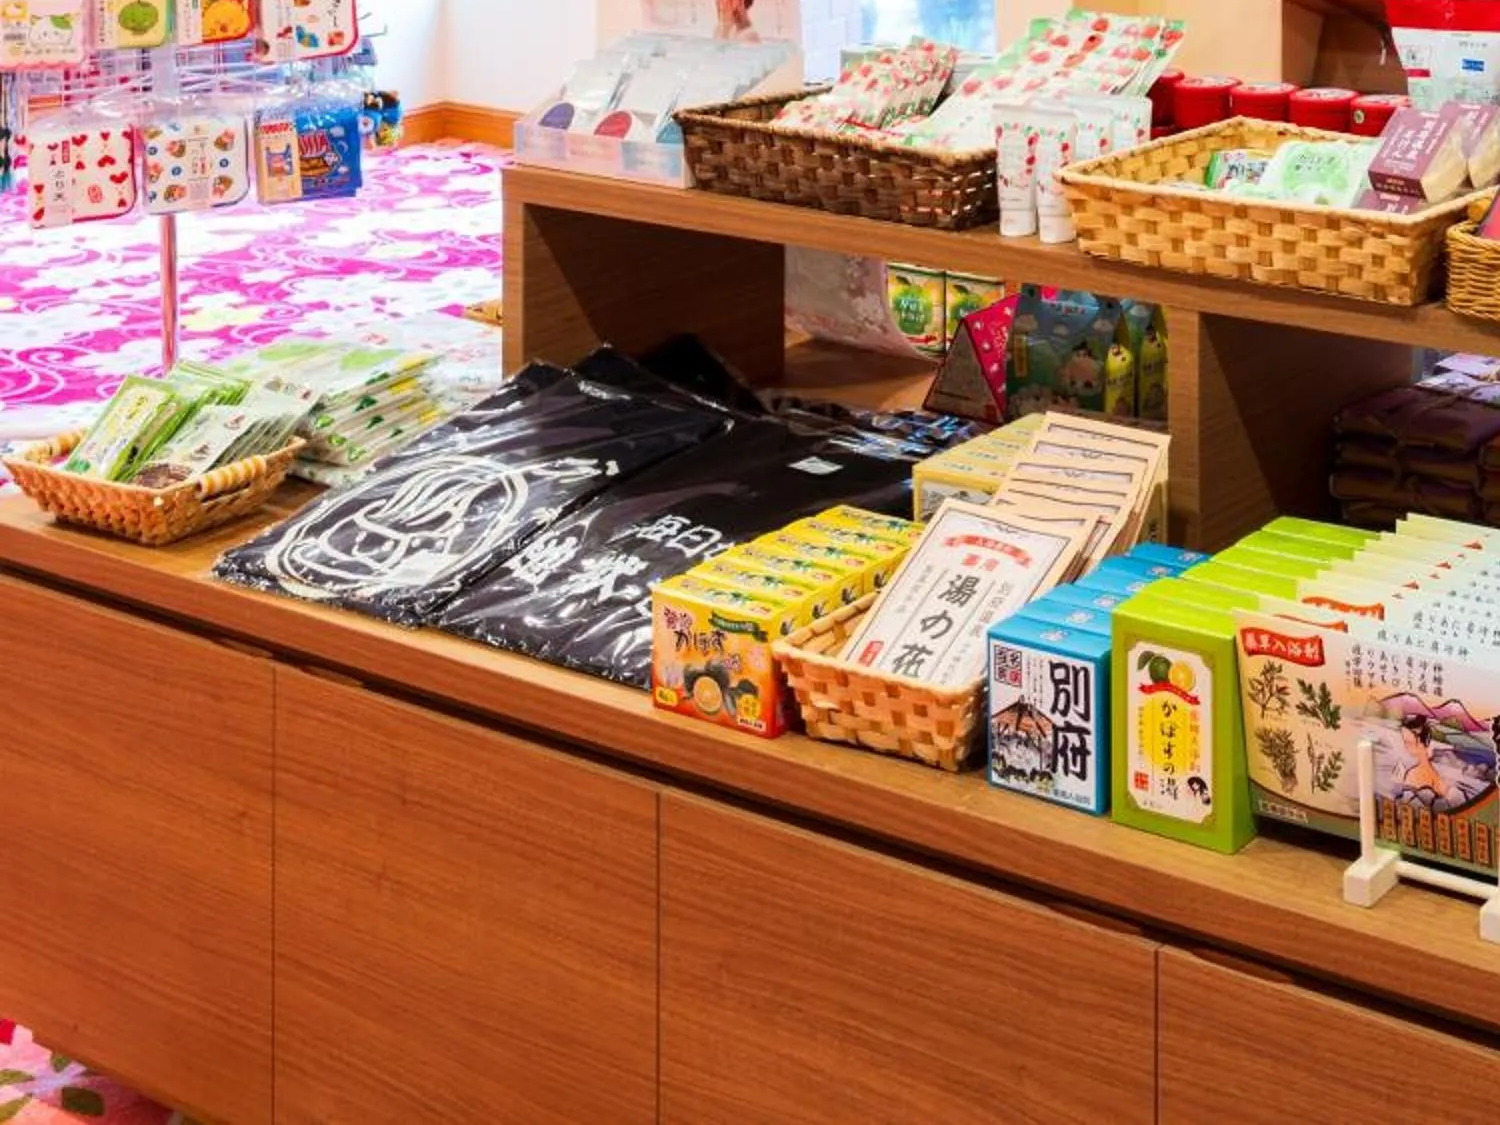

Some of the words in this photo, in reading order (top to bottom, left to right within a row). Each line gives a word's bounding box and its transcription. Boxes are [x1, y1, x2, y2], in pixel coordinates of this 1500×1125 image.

[893, 574, 981, 677] 湯の花
[1049, 659, 1092, 781] 別府
